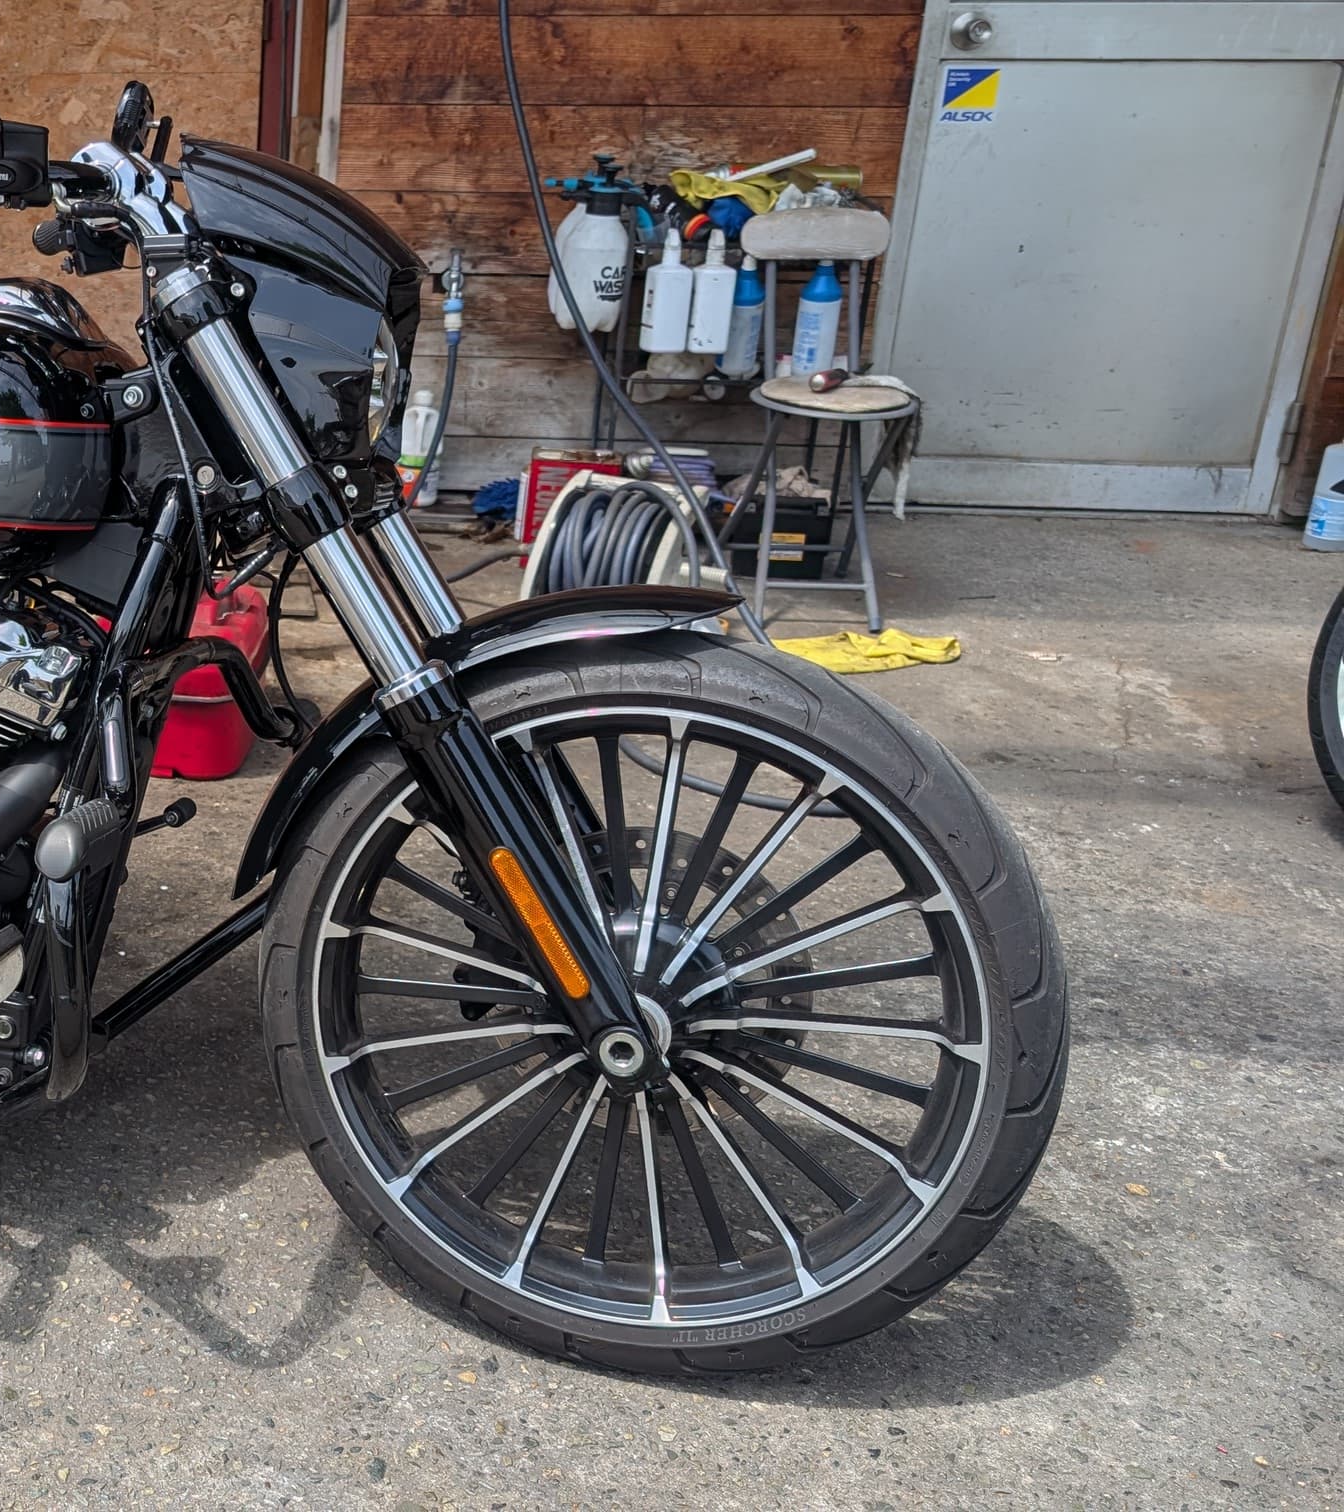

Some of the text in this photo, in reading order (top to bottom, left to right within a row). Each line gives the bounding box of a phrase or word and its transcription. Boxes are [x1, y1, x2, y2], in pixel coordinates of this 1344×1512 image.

[939, 111, 993, 122] ALSOK
[593, 280, 624, 293] WAS
[704, 1307, 807, 1342] SCORCHER
